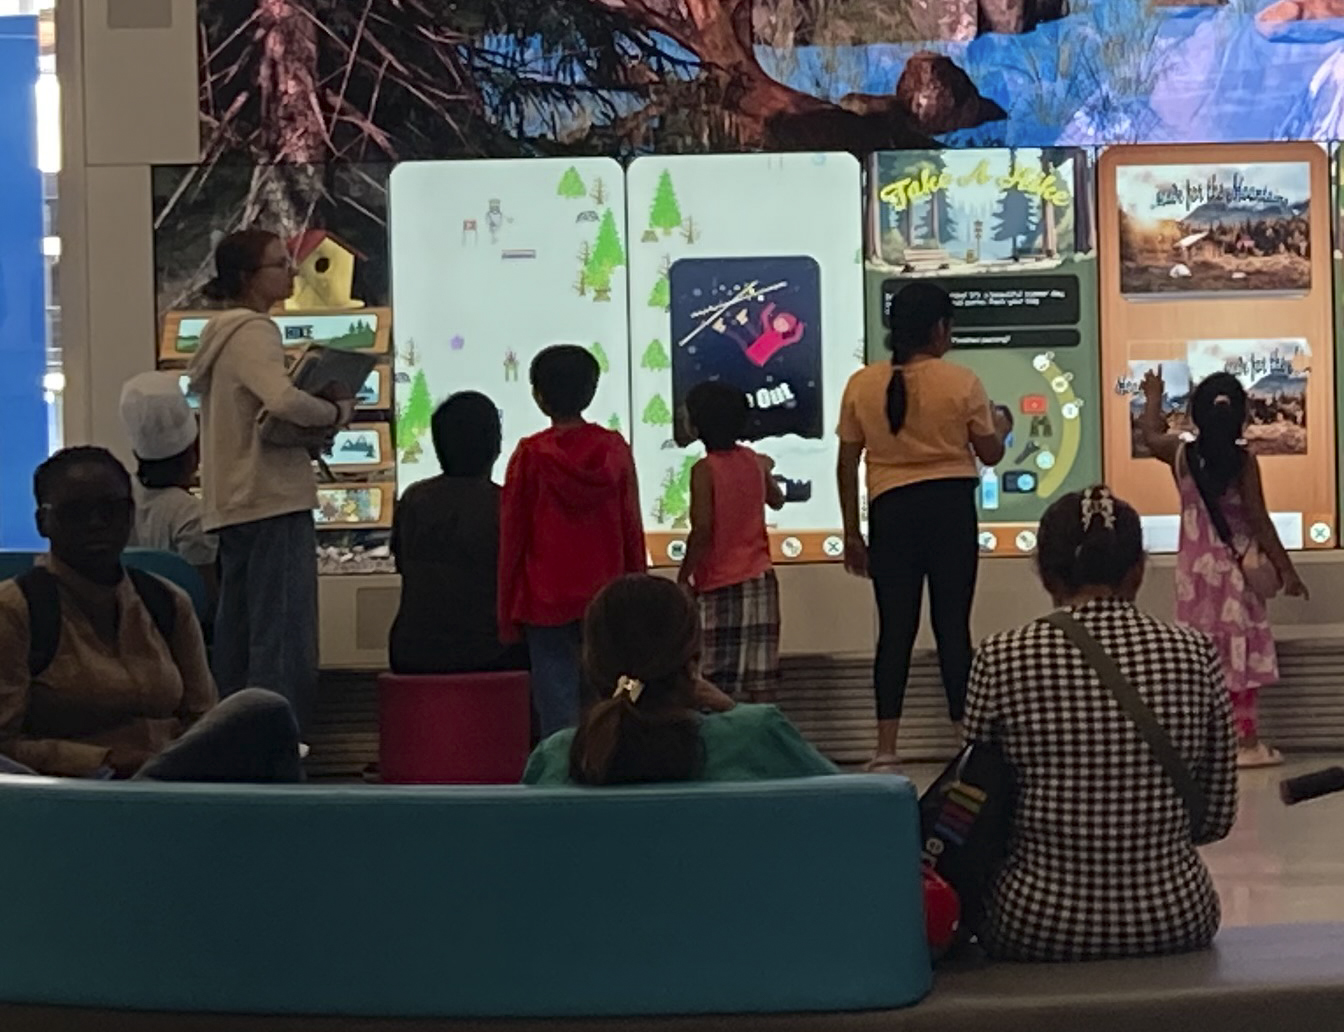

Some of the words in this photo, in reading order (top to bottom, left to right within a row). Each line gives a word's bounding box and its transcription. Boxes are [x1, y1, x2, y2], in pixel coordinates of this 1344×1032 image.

[880, 167, 951, 211] Take
[957, 158, 990, 187] A
[996, 160, 1070, 206] Hike
[756, 382, 795, 409] Out
